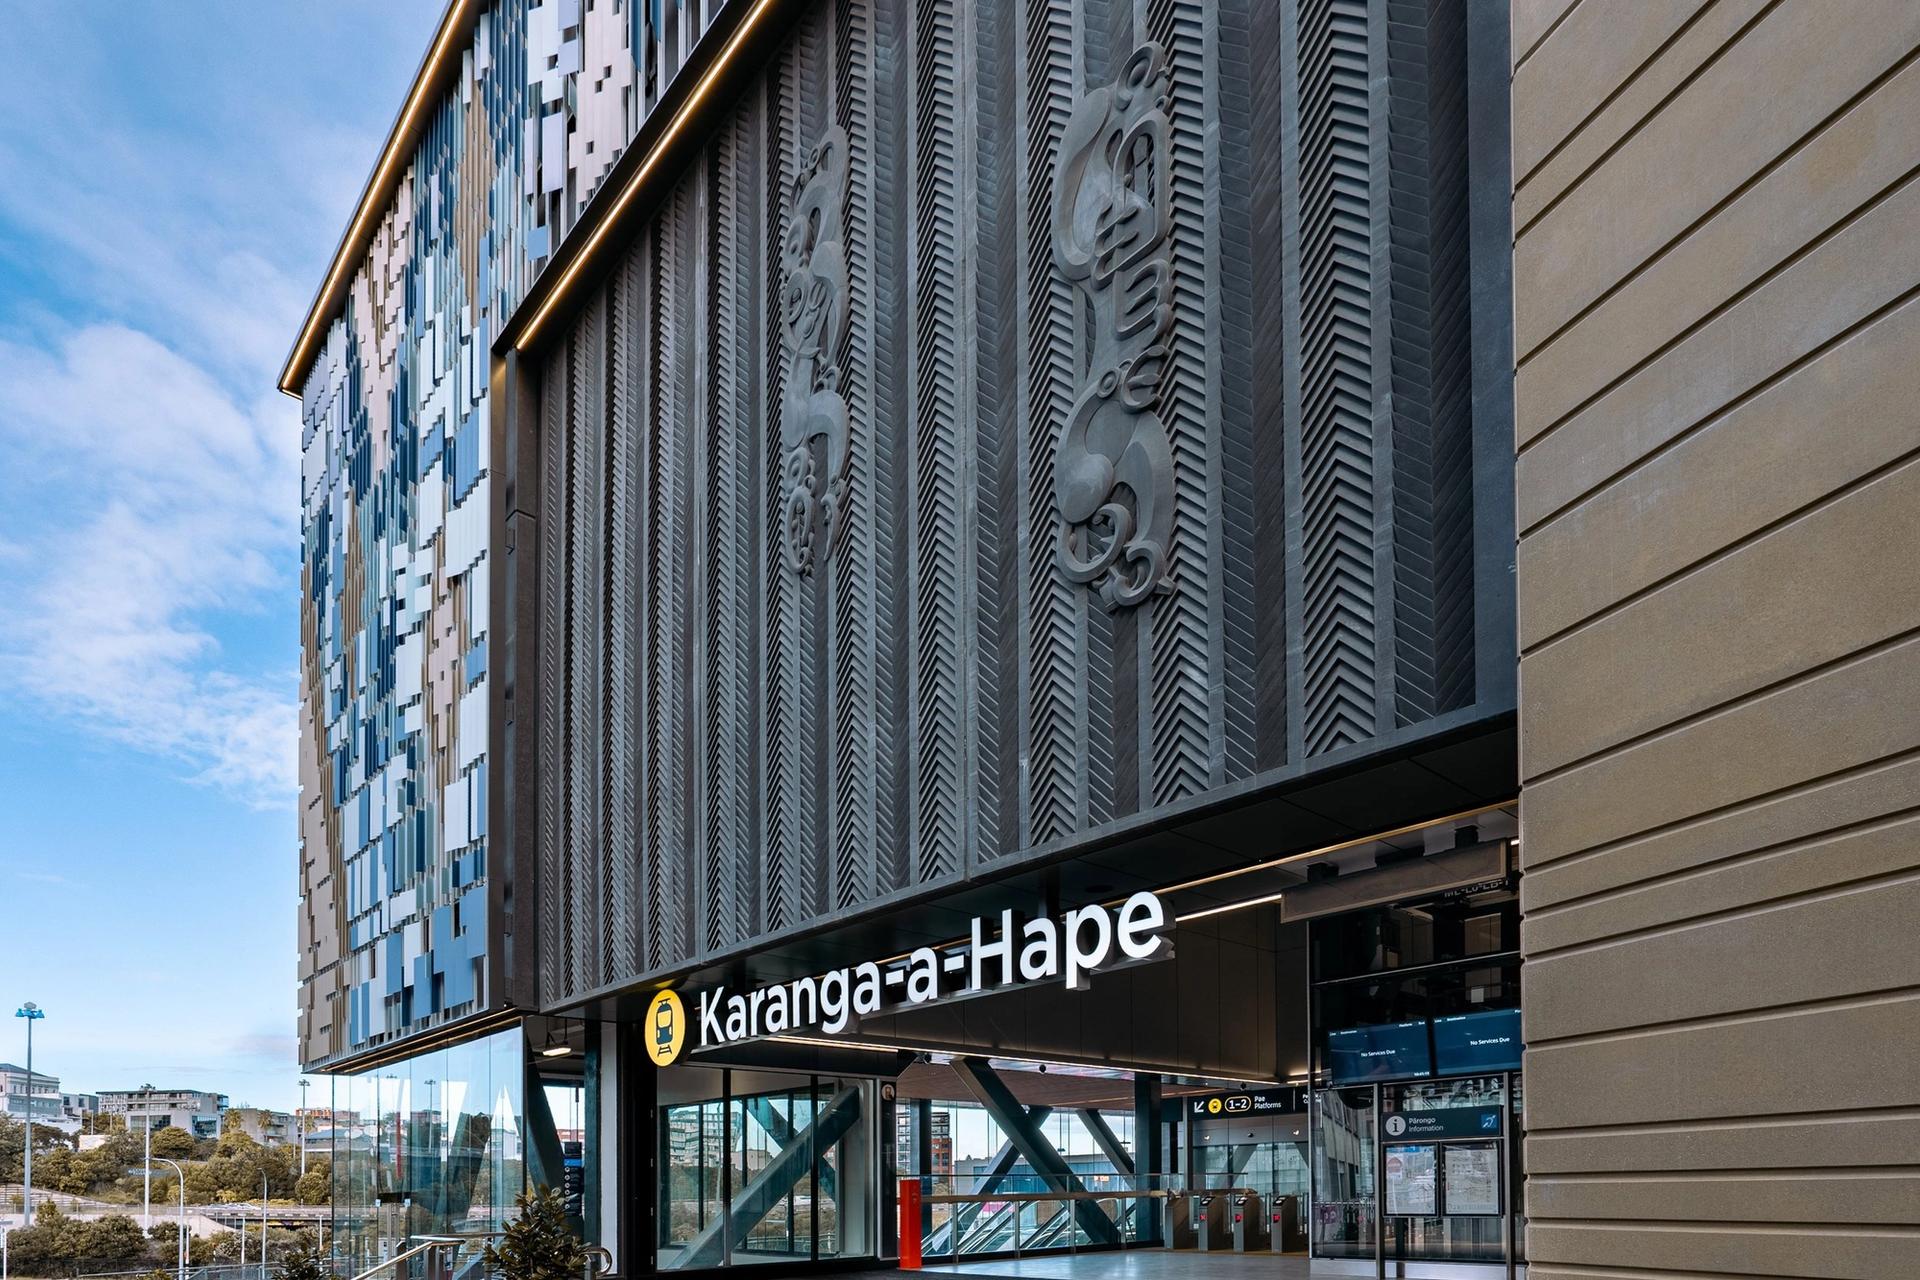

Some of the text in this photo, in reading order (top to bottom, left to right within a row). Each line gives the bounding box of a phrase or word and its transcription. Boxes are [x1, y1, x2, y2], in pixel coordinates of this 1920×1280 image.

[700, 891, 1165, 1046] Karanga-a-Hape
[1254, 1102, 1281, 1110] Platforms
[1408, 1125, 1444, 1133] Information
